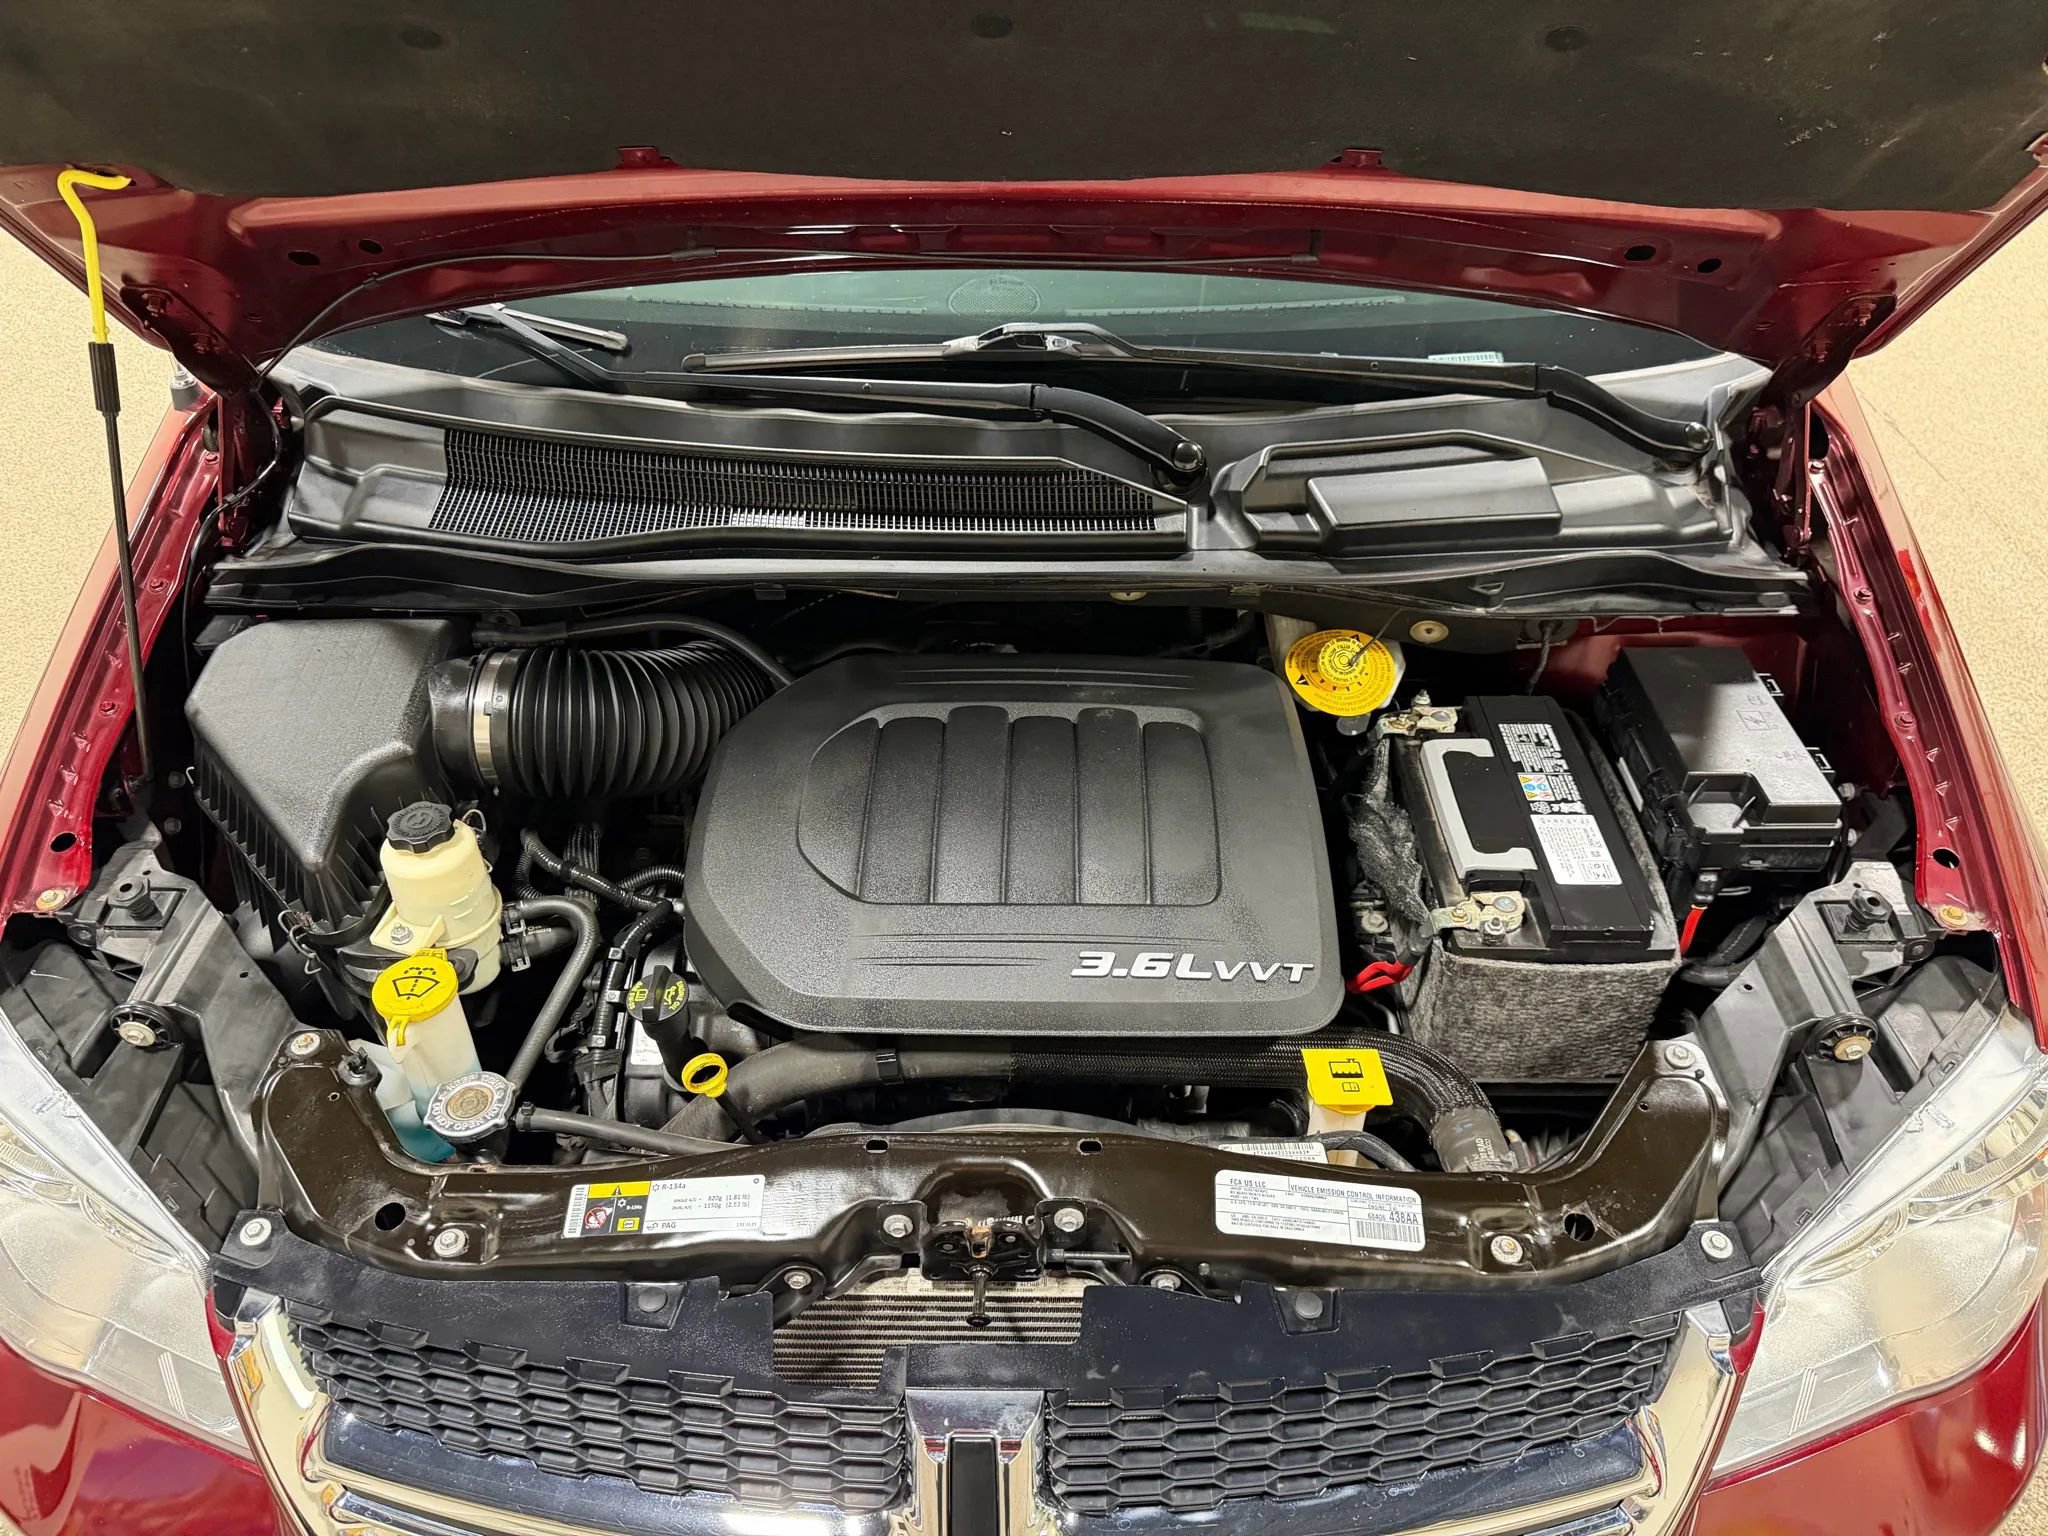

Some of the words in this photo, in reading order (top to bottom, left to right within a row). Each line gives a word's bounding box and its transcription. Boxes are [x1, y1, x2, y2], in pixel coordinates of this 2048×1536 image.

[454, 1118, 485, 1130] OPEN
[485, 1103, 504, 1120] HOT
[661, 1182, 686, 1191] R-134a
[1244, 1179, 1253, 1187] US
[1254, 1180, 1267, 1188] LLC
[1290, 1185, 1314, 1194] VEHICLE
[1316, 1187, 1345, 1197] EMISSION
[1346, 1190, 1374, 1200] CONTROL
[1375, 1193, 1417, 1203] INFORMATION
[661, 1221, 677, 1229] PAG
